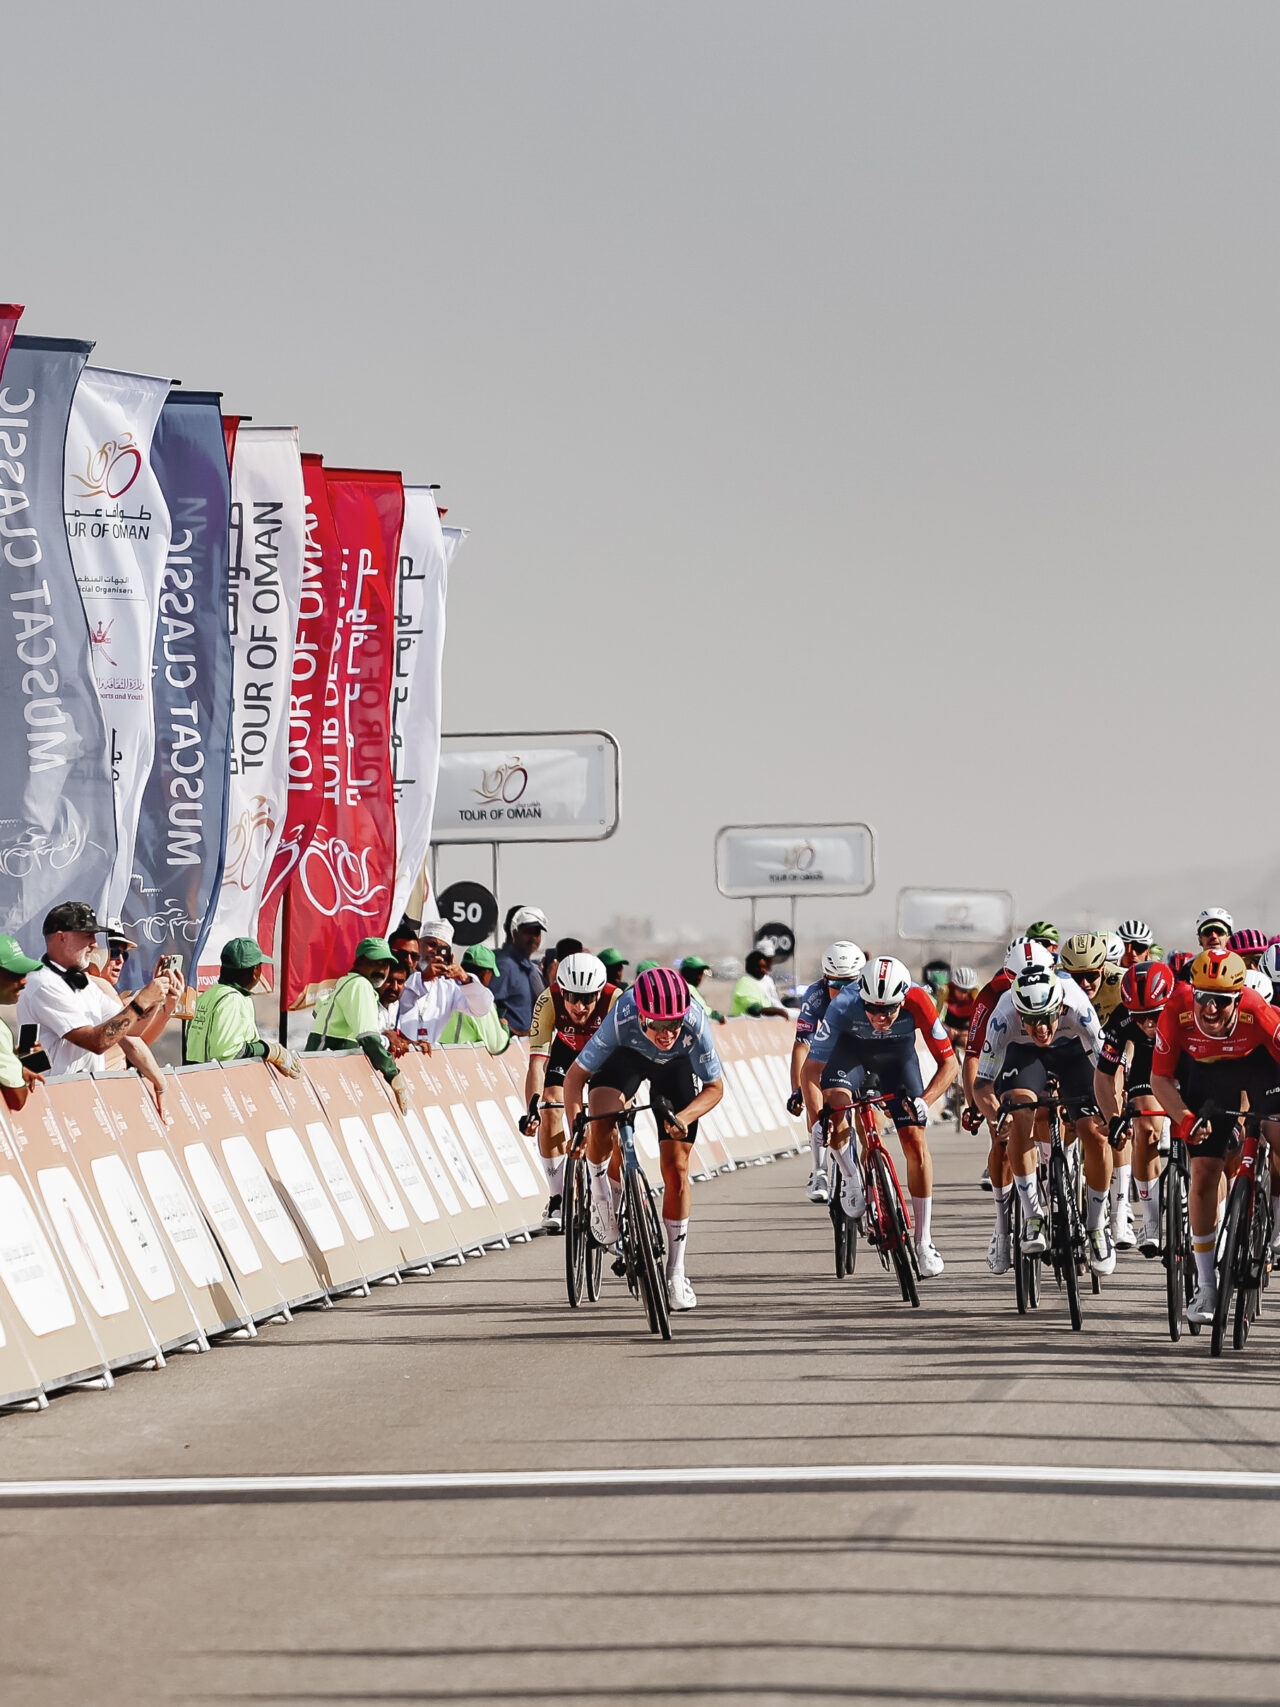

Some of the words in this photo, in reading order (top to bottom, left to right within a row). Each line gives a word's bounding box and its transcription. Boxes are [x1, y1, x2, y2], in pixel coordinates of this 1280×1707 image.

[91, 523, 109, 538] OF
[112, 523, 150, 540] OMAN
[252, 502, 283, 614] OMAN
[95, 586, 134, 595] Organisers
[247, 625, 278, 670] OF
[241, 681, 273, 775] TOUR
[287, 693, 313, 792] TOUR
[459, 809, 487, 821] TOUR
[490, 809, 503, 820] OF
[507, 807, 542, 819] OMAN
[452, 902, 482, 923] 50
